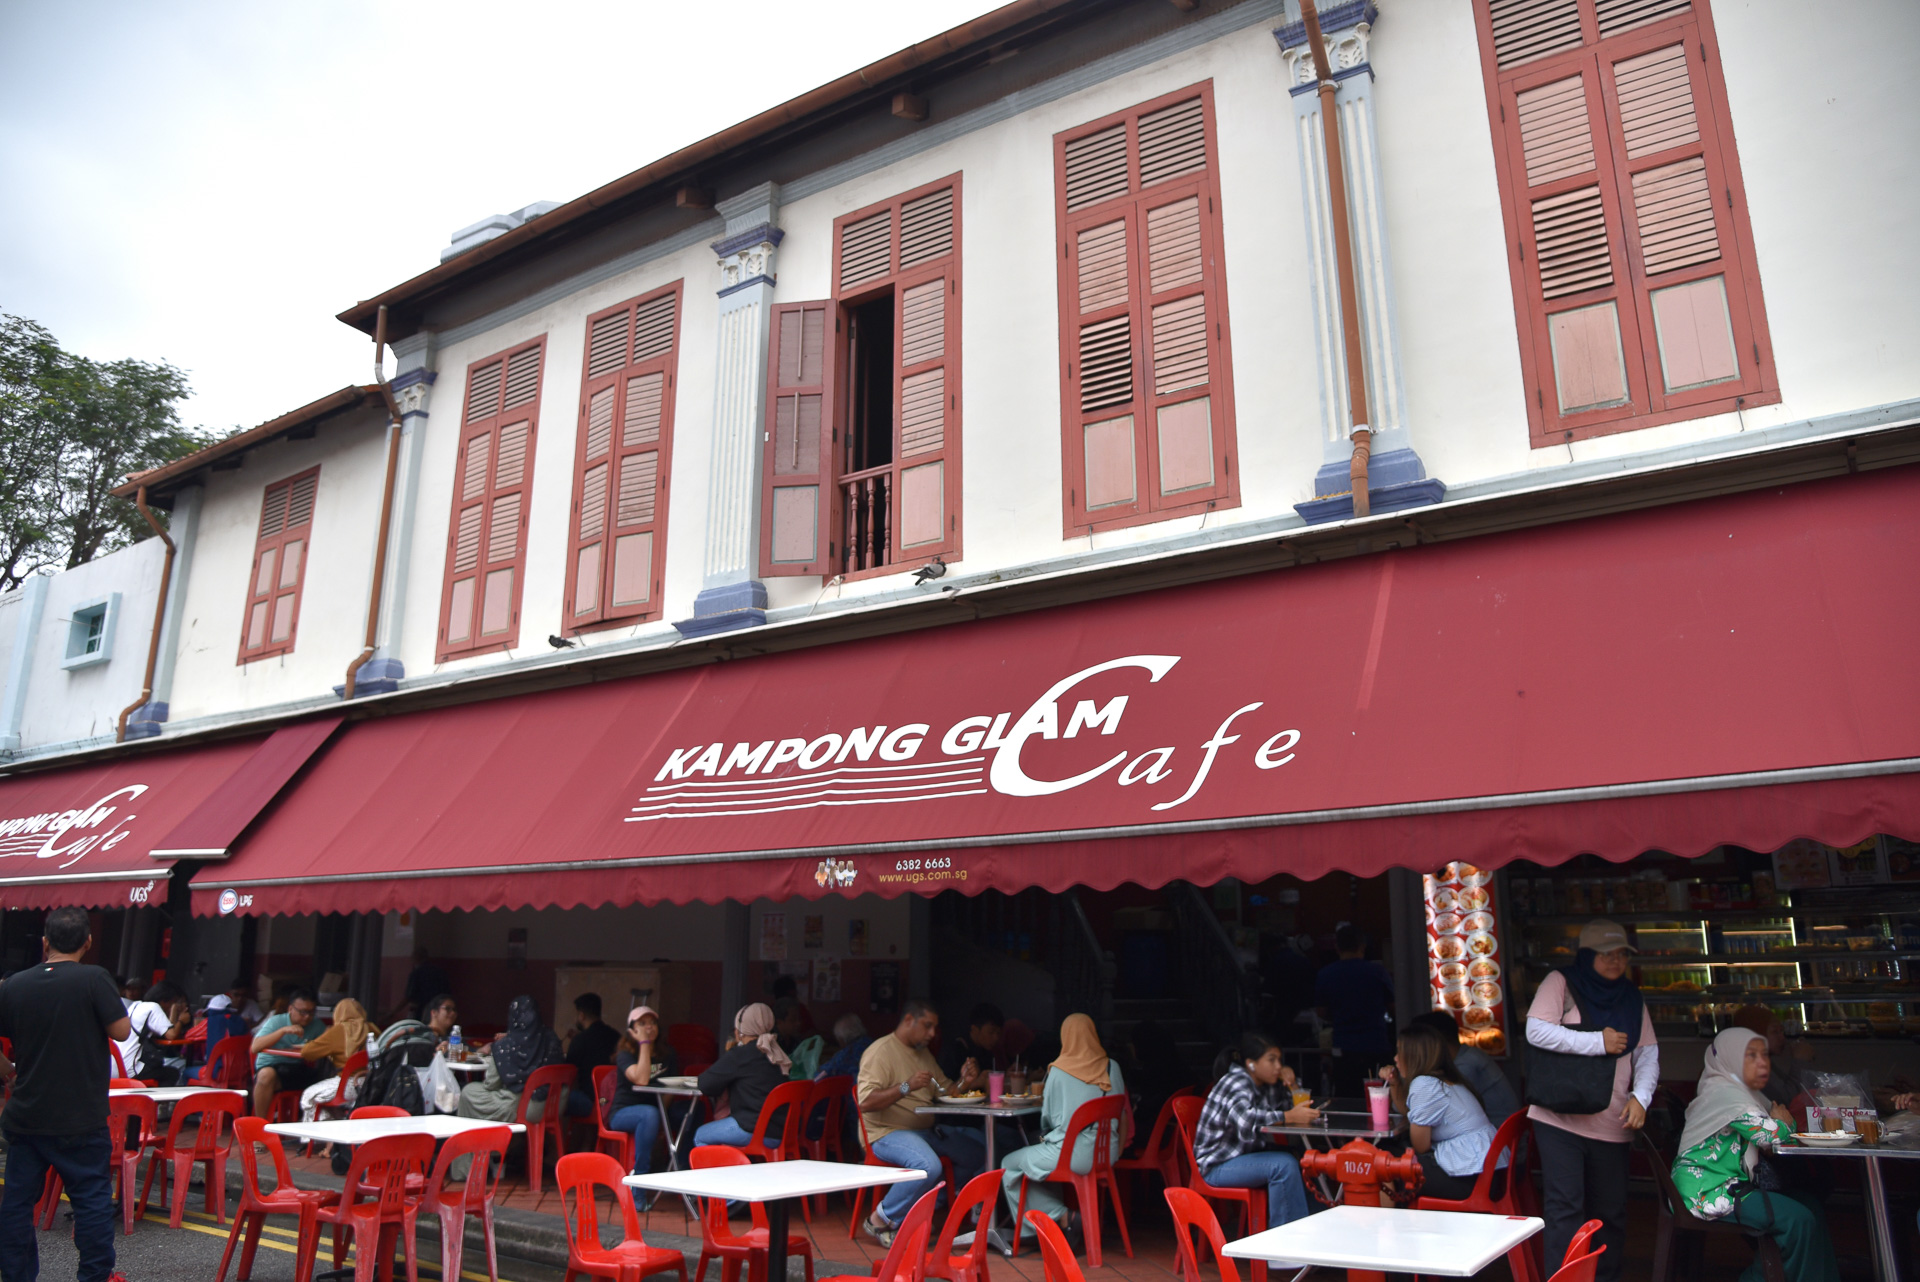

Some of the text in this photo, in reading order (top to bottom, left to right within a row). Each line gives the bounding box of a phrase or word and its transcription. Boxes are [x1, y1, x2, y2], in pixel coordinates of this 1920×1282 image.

[655, 694, 1130, 782] KAMPONG GLAM
[989, 655, 1301, 811] Cafe
[36, 783, 150, 869] Cafe
[47, 806, 118, 831] GLAM
[896, 857, 951, 871] 6382 6663
[879, 870, 968, 883] www.ugs.com.sg
[129, 886, 149, 903] UGS
[239, 894, 254, 907] LPG
[1344, 1160, 1372, 1176] 1067
